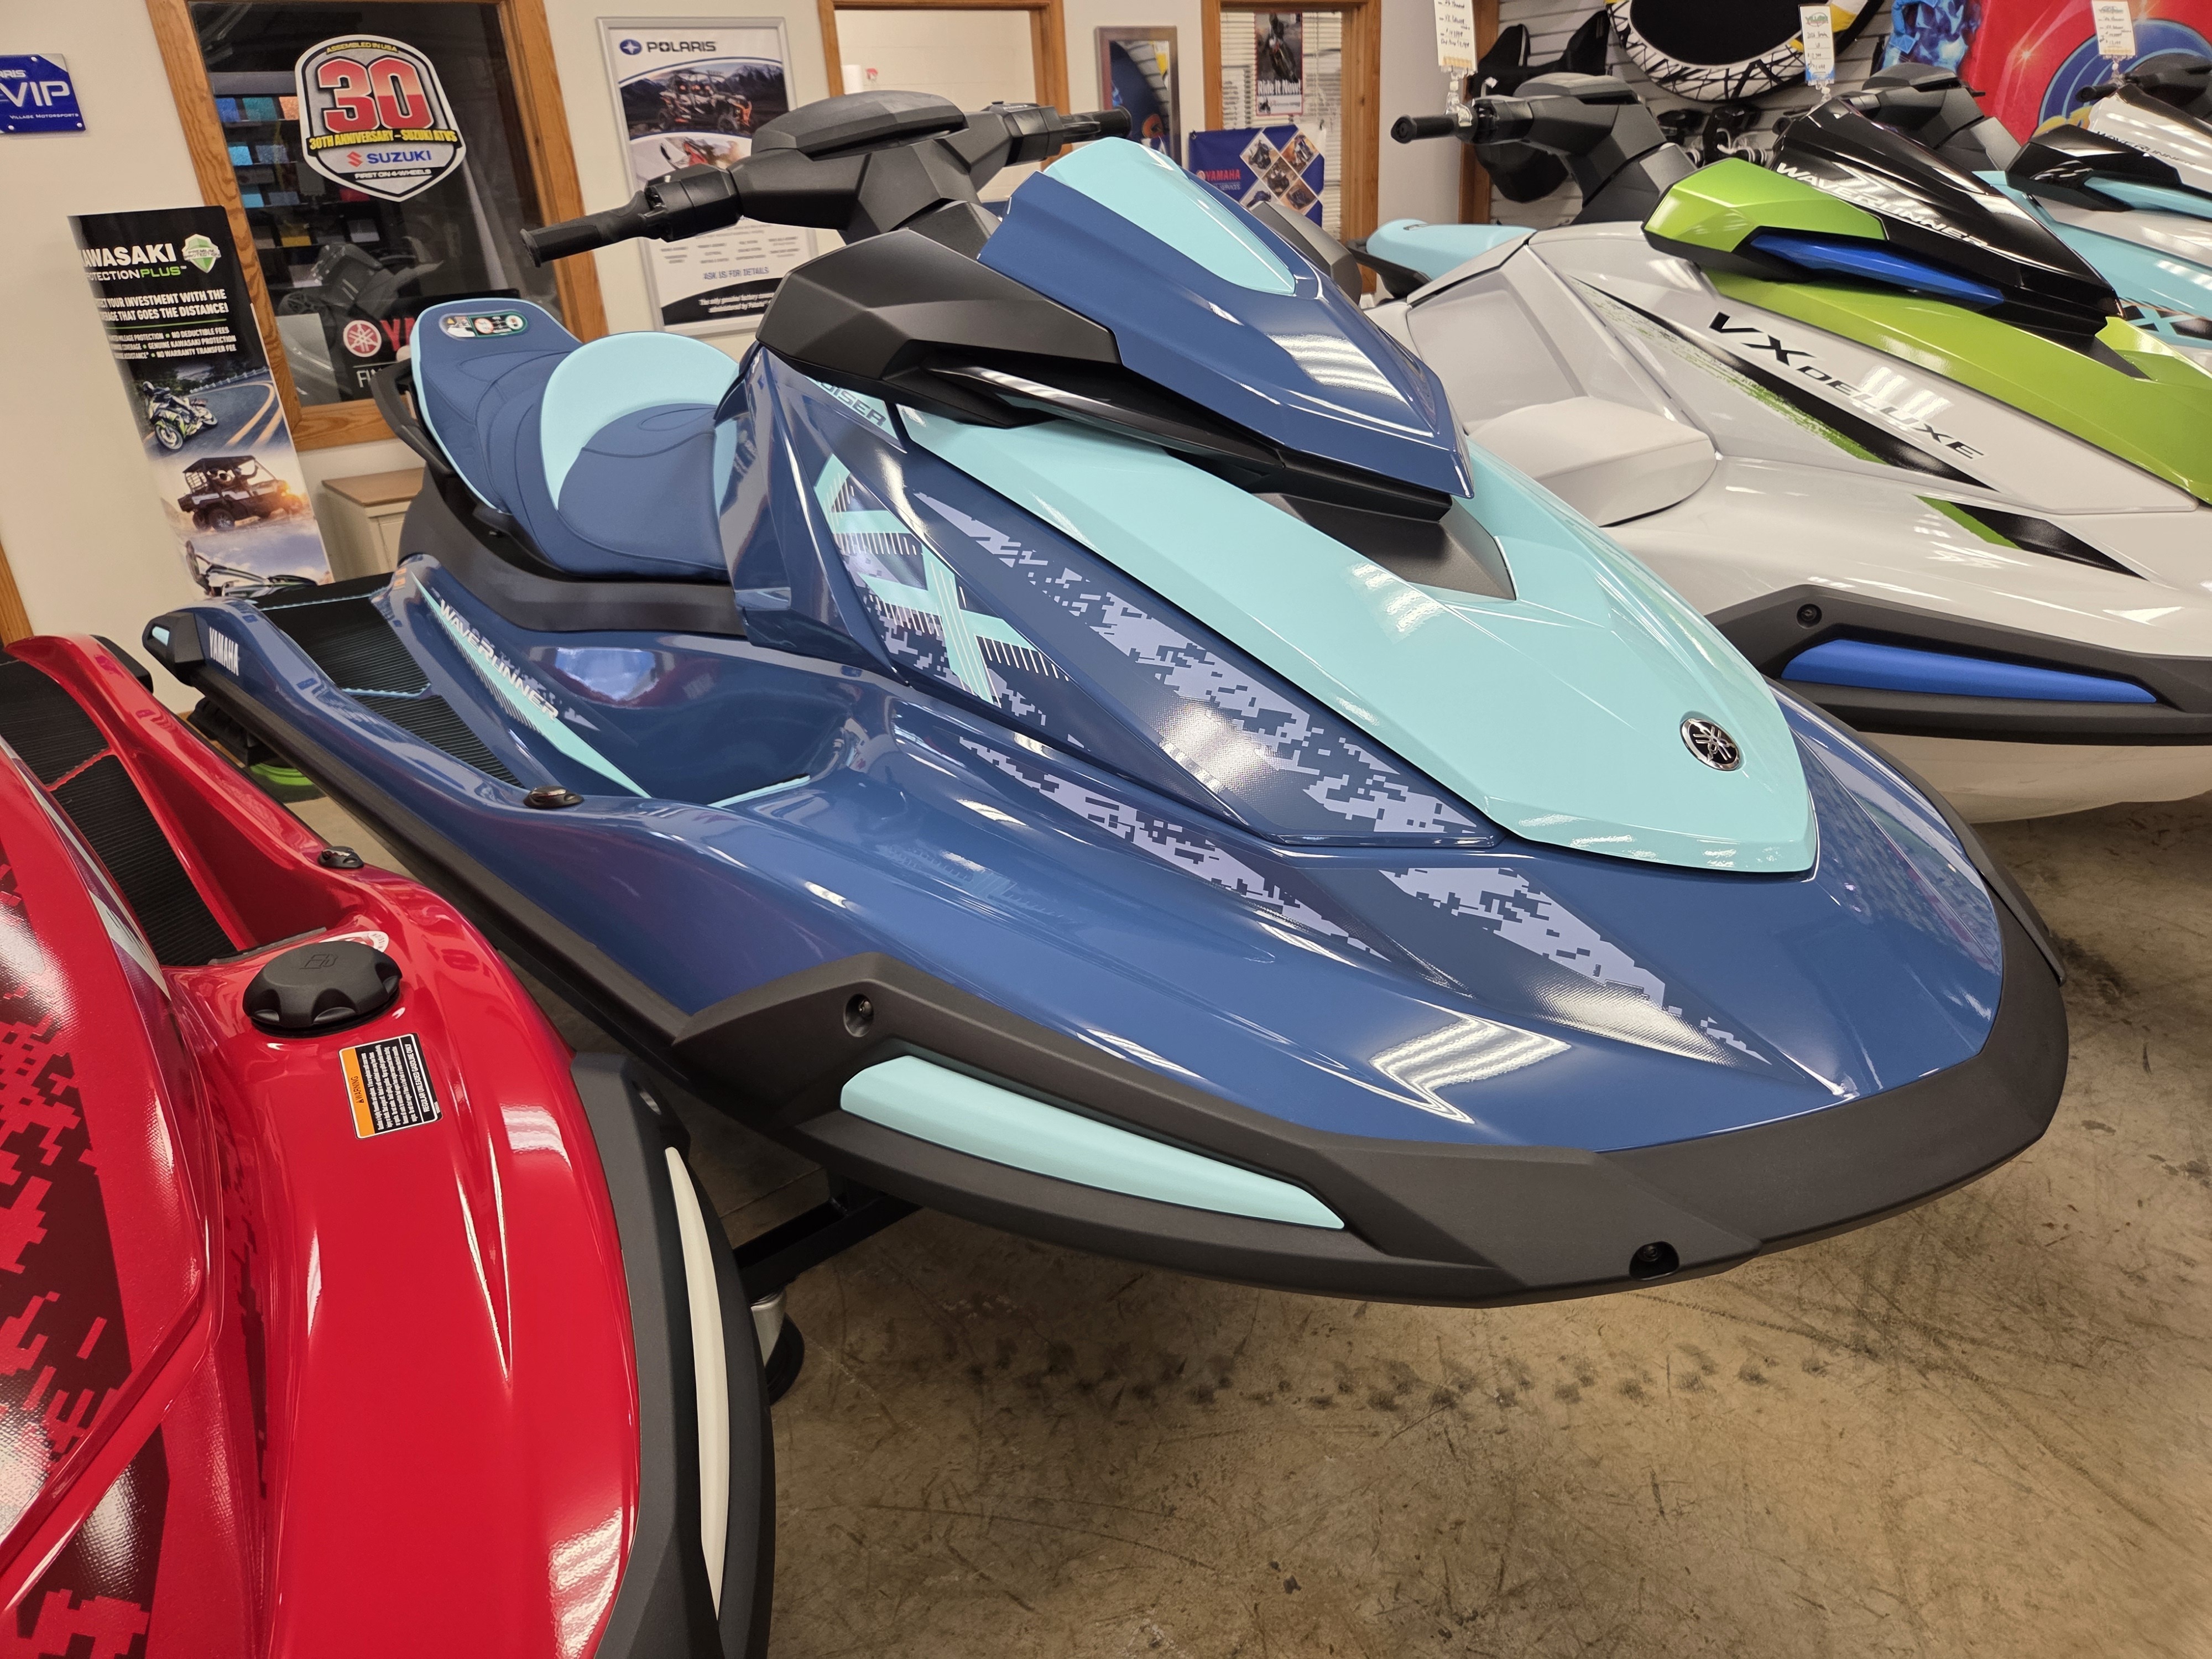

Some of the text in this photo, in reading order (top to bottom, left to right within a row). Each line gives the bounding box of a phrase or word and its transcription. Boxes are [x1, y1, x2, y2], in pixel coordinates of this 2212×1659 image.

[381, 44, 398, 52] USA
[647, 41, 717, 53] POLARIS
[0, 81, 70, 107] VIP
[317, 57, 434, 133] 30
[310, 134, 334, 150] 30TH
[335, 130, 394, 146] ANNIVERSARY
[400, 129, 434, 141] SUZUKI
[367, 150, 432, 164] SUZUKI
[1206, 169, 1241, 181] YAMAHA
[1776, 163, 1988, 247] WAVERUNNER
[106, 297, 126, 307] YOUR
[125, 293, 179, 307] INVESTMENT
[179, 290, 207, 303] WITH
[207, 289, 227, 300] THE
[118, 310, 137, 321] THAT
[138, 309, 160, 320] GOES
[159, 307, 179, 319] THE
[179, 302, 229, 317] DISTANCE!
[1796, 366, 1985, 460] DELUXE
[209, 626, 239, 676] YAMAHA
[441, 598, 559, 721] WAVERUNNER
[351, 1076, 363, 1102] WARNING
